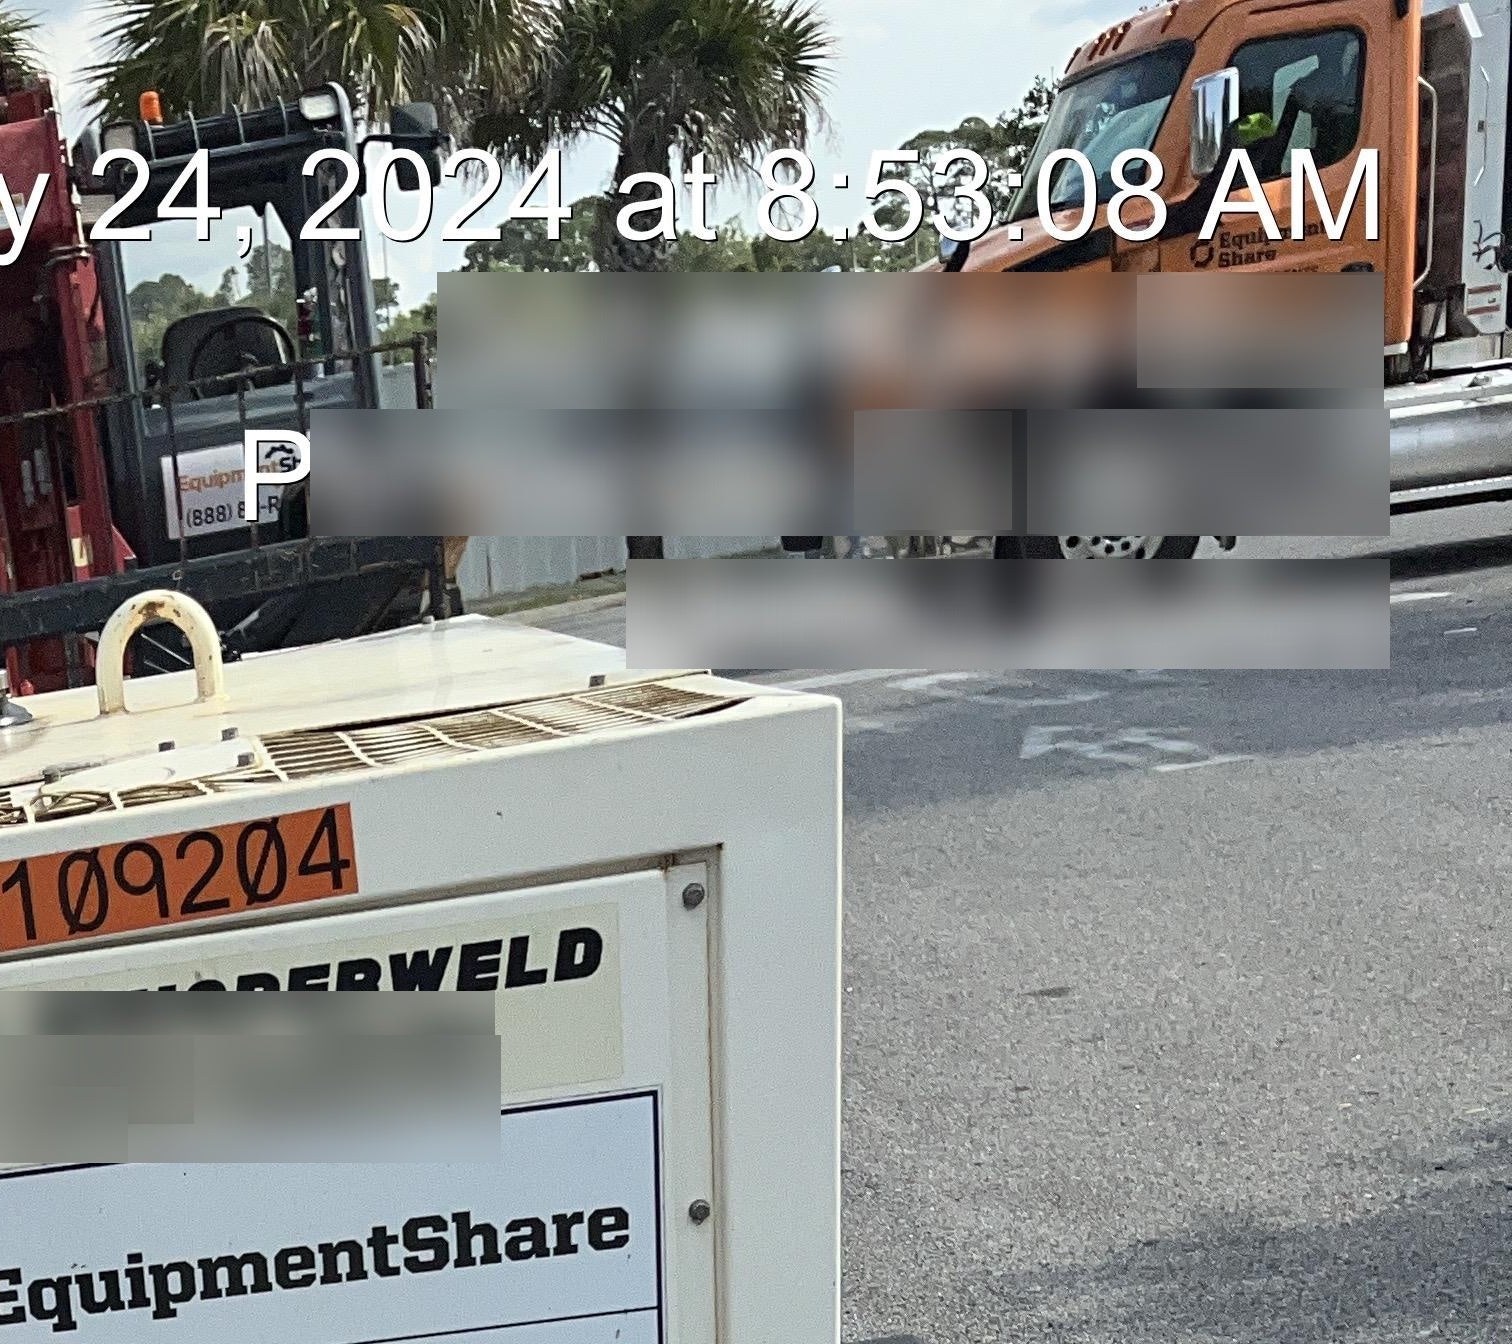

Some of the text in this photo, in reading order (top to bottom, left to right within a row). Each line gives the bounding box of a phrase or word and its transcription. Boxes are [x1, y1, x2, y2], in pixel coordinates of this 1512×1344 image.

[1218, 249, 1277, 268] Share
[187, 503, 233, 528] (888)
[0, 806, 351, 941] 109204
